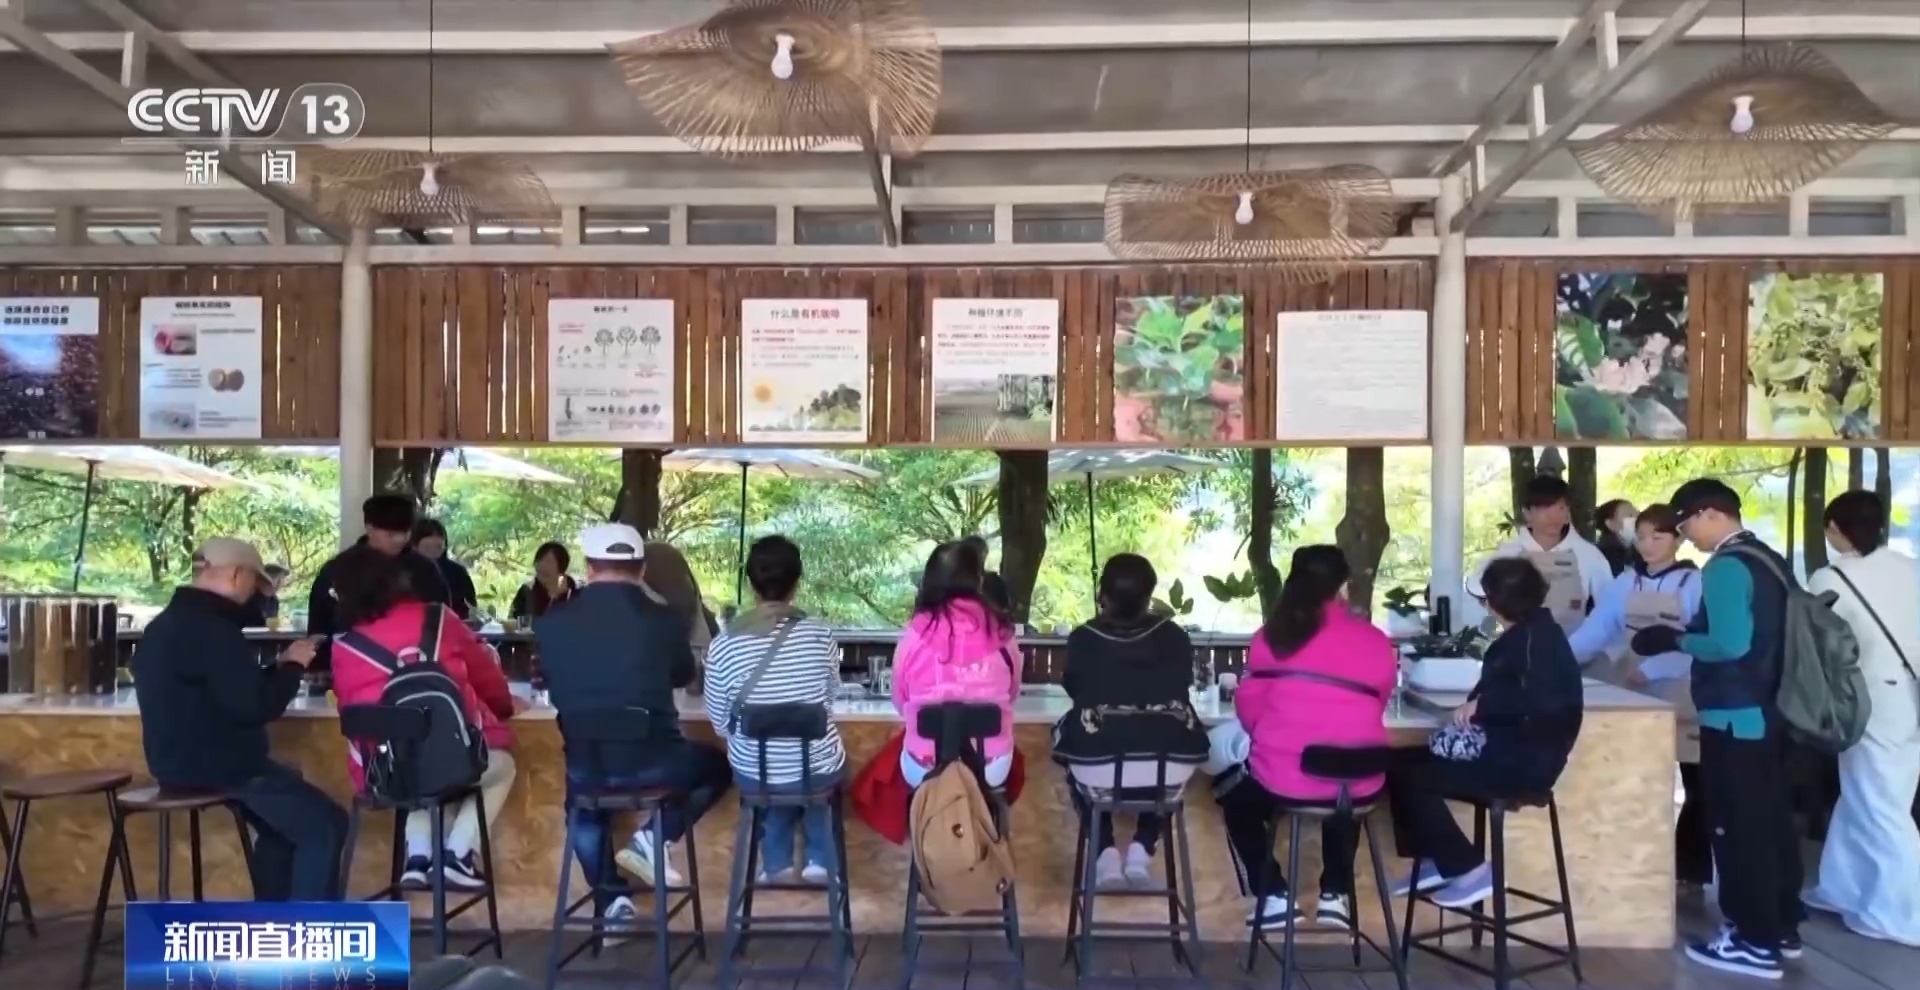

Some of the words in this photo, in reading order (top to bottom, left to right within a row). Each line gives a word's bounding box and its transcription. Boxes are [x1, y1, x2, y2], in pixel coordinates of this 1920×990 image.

[770, 308, 840, 319] 什么是有机咖啡
